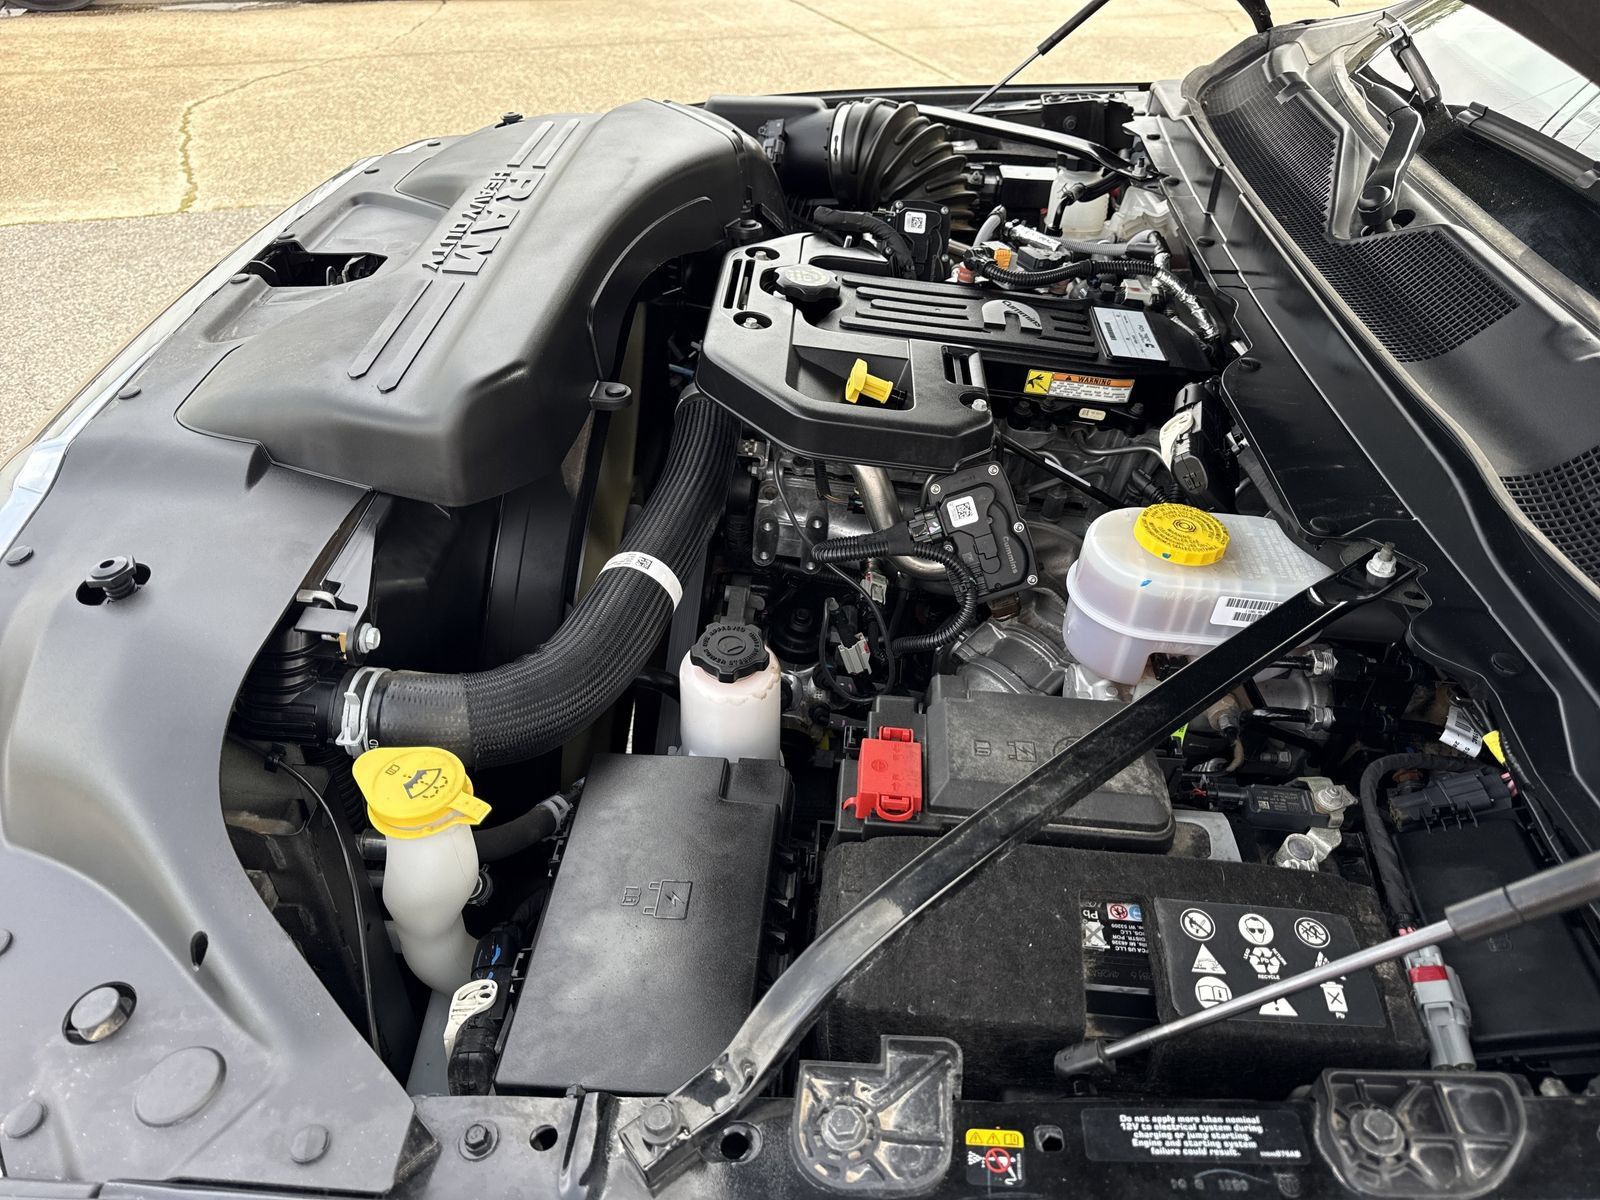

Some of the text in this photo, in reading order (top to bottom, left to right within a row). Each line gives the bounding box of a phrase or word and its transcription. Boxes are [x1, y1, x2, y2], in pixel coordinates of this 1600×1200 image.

[421, 171, 512, 273] HEAVY DUTY
[442, 171, 545, 276] RAM
[1002, 300, 1041, 328] Cummins
[1078, 376, 1112, 386] WARNING
[1003, 536, 1018, 574] Cummins
[1082, 909, 1099, 919] Pb
[1119, 1114, 1132, 1122] Do
[1152, 1114, 1176, 1124] apply
[1202, 1115, 1224, 1124] than
[1225, 1116, 1260, 1124] nominal
[1120, 1122, 1139, 1130] 12V
[1154, 1122, 1197, 1132] electrical
[1198, 1124, 1232, 1132] system
[1233, 1124, 1264, 1134] during
[1133, 1130, 1173, 1140] charging
[1187, 1130, 1210, 1140] jump
[1210, 1132, 1252, 1142] starting.
[1132, 1138, 1258, 1150] Engine and starting system
[1150, 1146, 1242, 1156] failure could result.
